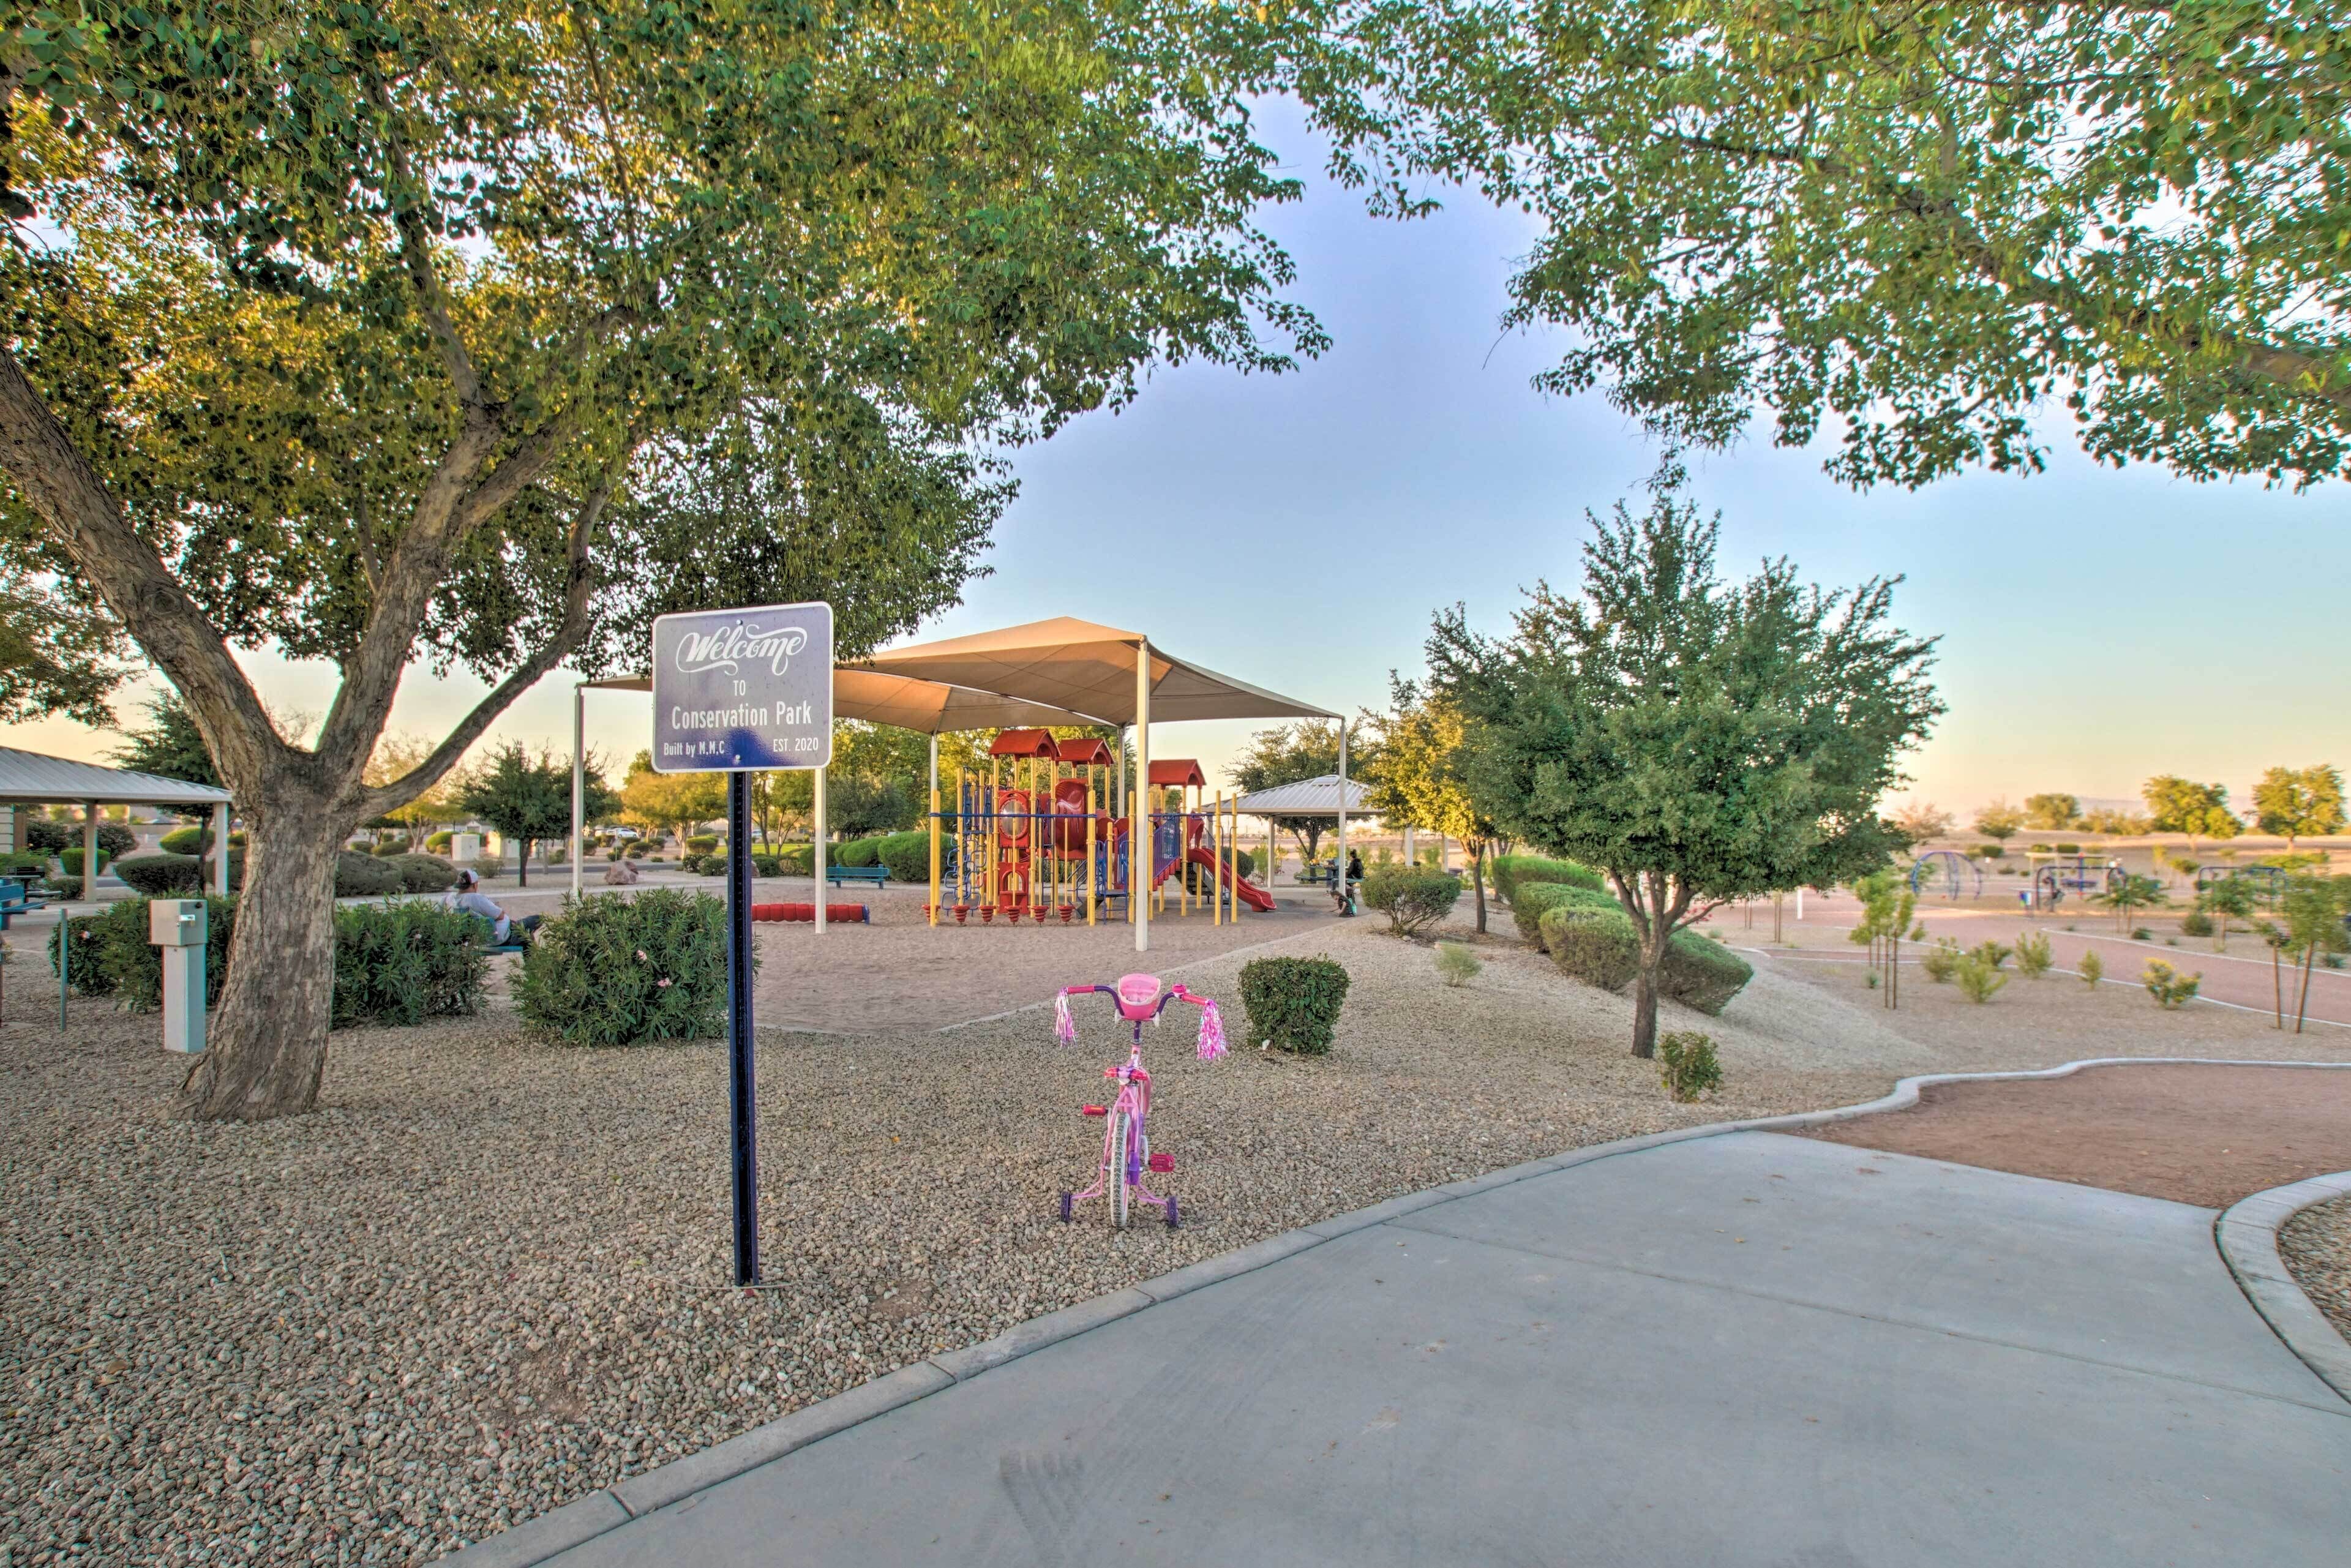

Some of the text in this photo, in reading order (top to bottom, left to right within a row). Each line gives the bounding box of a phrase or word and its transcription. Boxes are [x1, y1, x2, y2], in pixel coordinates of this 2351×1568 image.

[676, 624, 808, 676] Welcome
[733, 680, 746, 696] TO
[672, 700, 812, 730] Conservation Park
[664, 741, 683, 756] Built
[686, 743, 696, 757] by
[773, 737, 819, 752] EST. 2020
